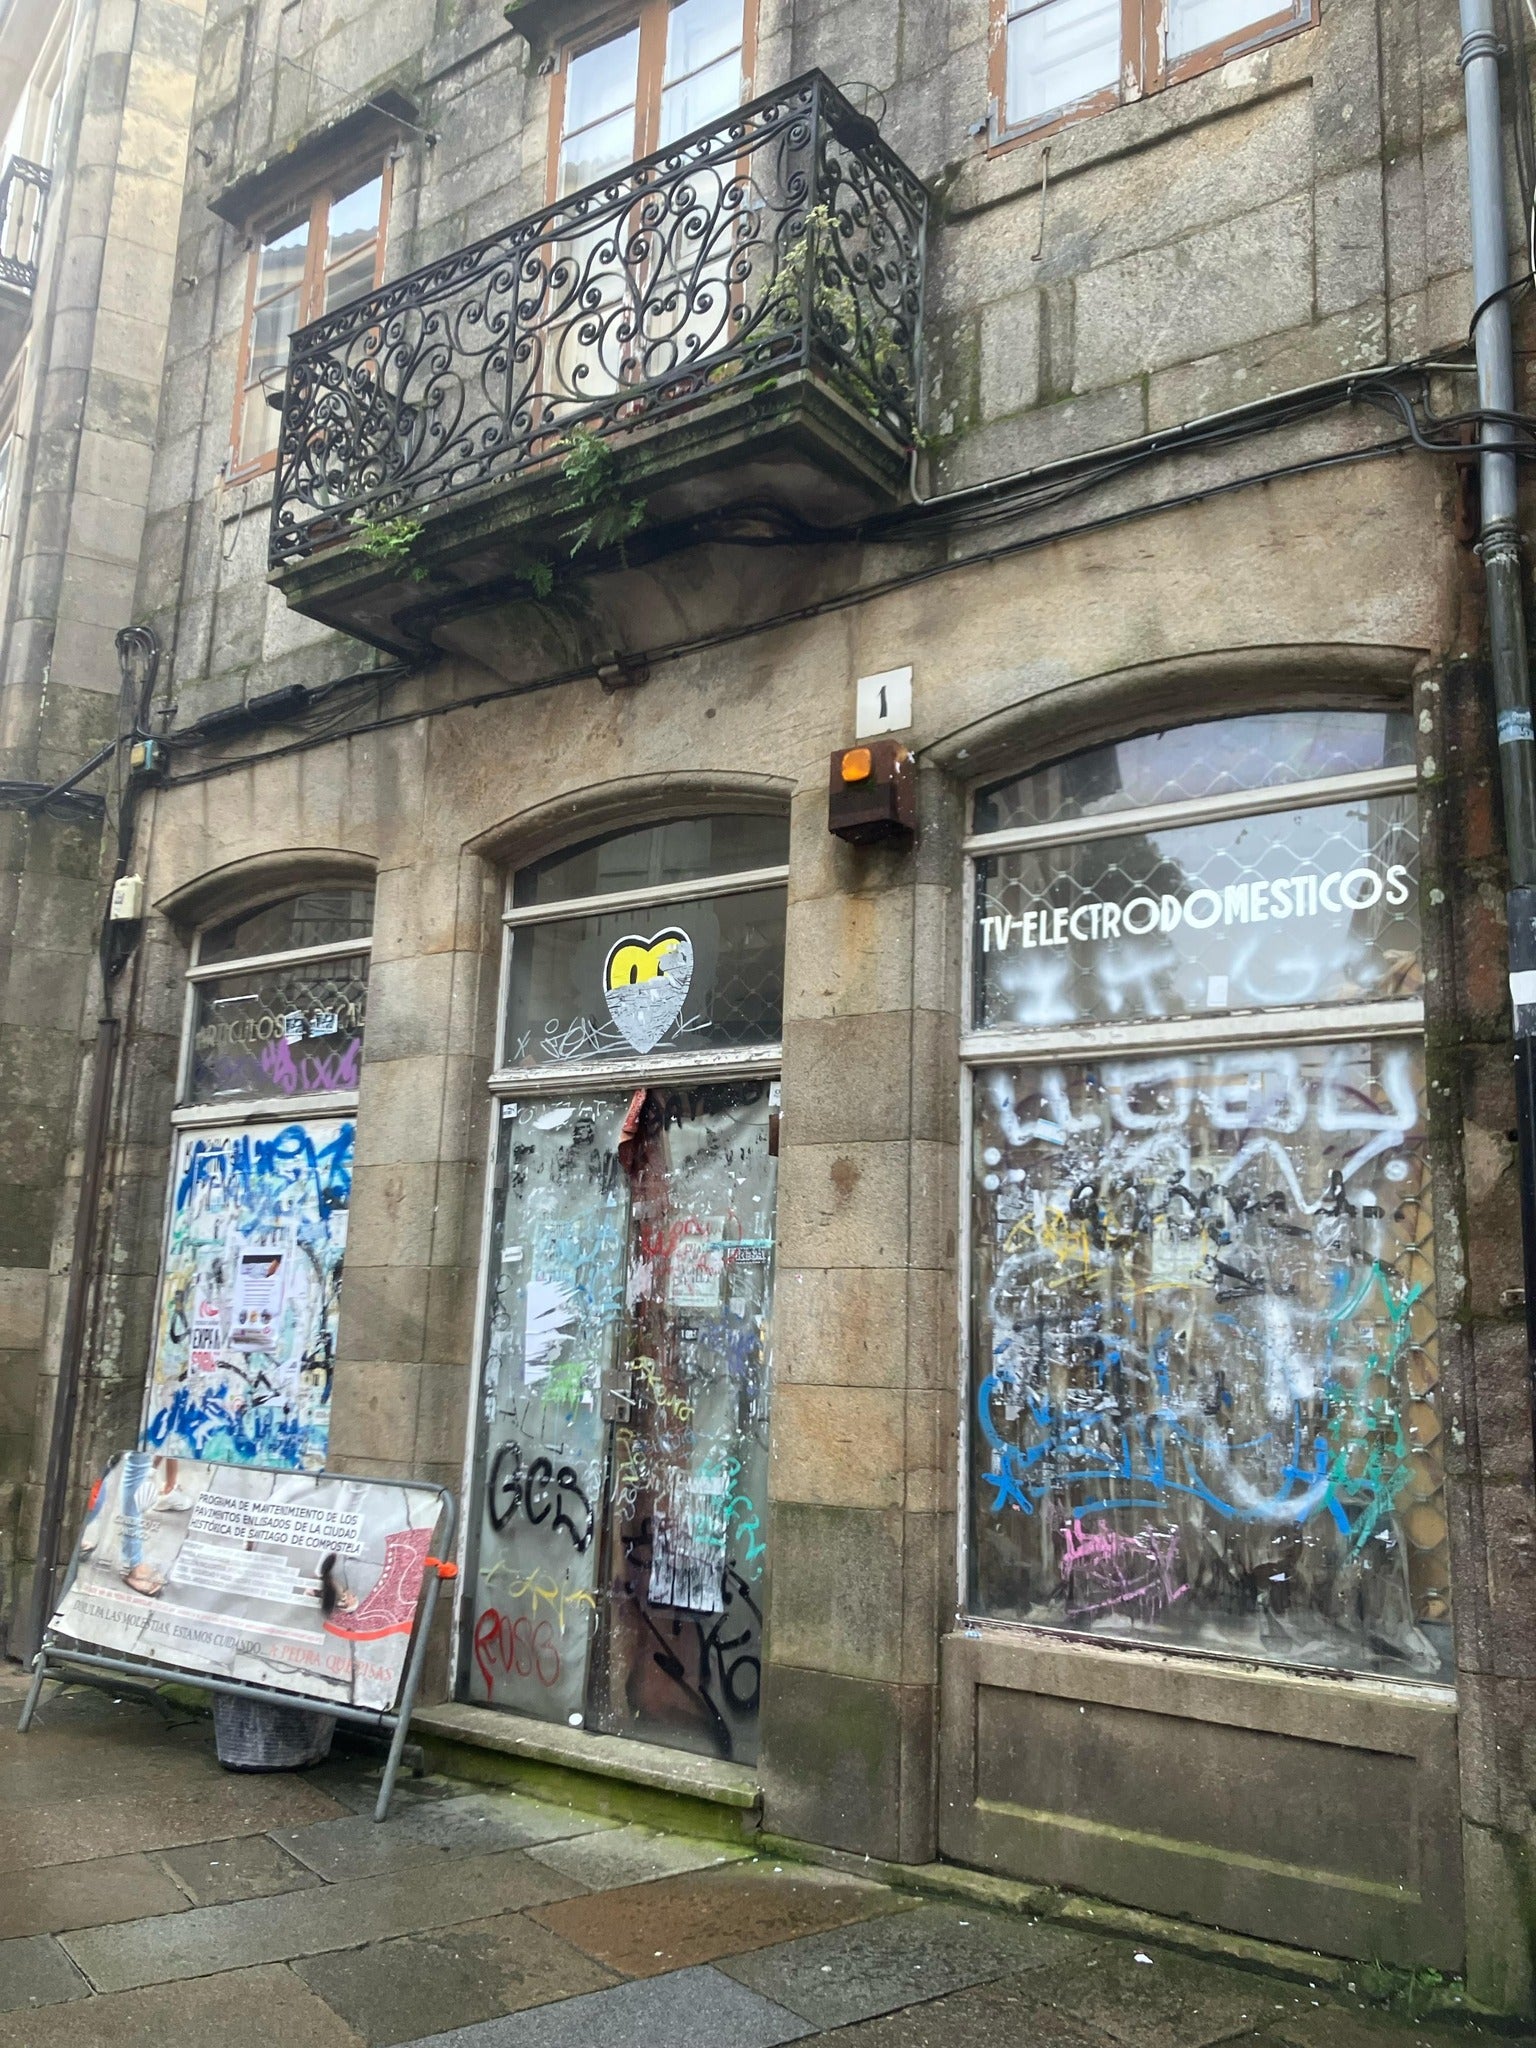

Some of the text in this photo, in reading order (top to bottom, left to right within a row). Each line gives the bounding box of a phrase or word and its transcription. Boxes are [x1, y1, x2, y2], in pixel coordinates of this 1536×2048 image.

[877, 685, 888, 719] 1
[980, 864, 1409, 953] TV-ELECTRODOMESTICOS
[326, 1511, 338, 1522] DE
[340, 1514, 358, 1525] LOS
[234, 1526, 246, 1538] DE
[291, 1534, 304, 1545] DE
[294, 1520, 307, 1532] DE
[309, 1524, 321, 1535] LA
[323, 1525, 358, 1539] CIUDAD
